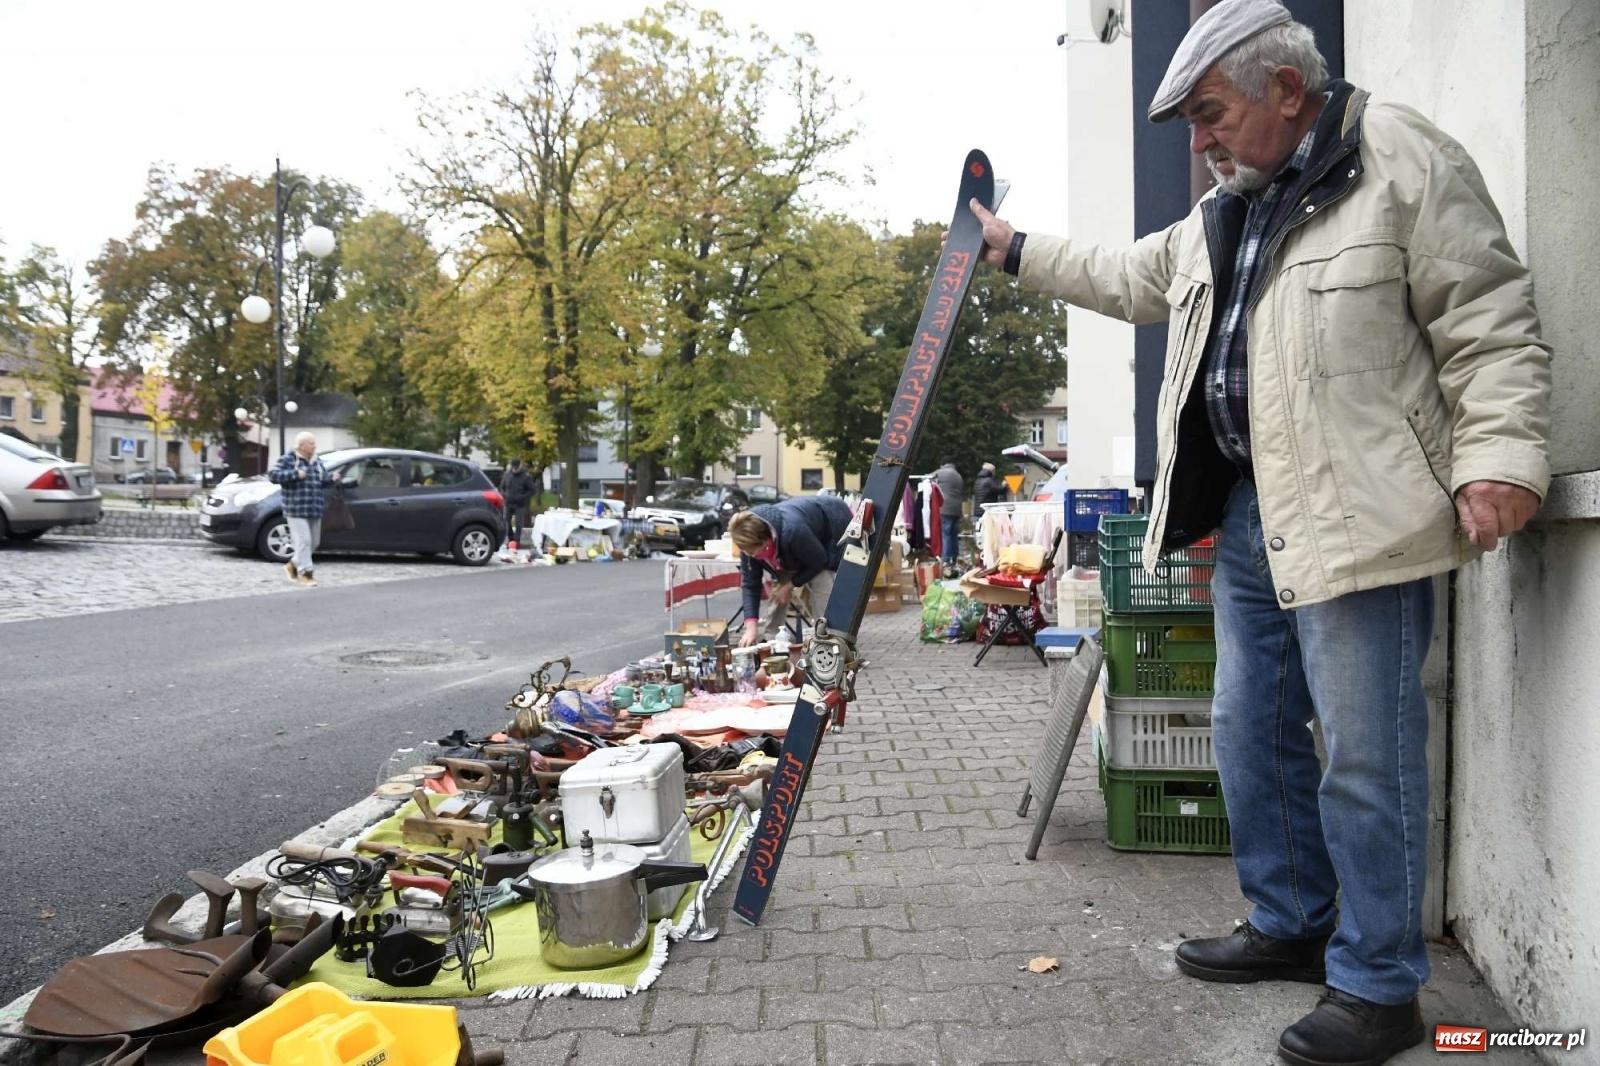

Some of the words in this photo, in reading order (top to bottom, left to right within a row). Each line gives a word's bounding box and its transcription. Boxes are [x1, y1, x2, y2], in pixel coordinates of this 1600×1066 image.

[938, 252, 970, 293] 212
[931, 296, 954, 332] ALU
[885, 331, 941, 450] COMPACT
[747, 752, 804, 888] POLSPORT
